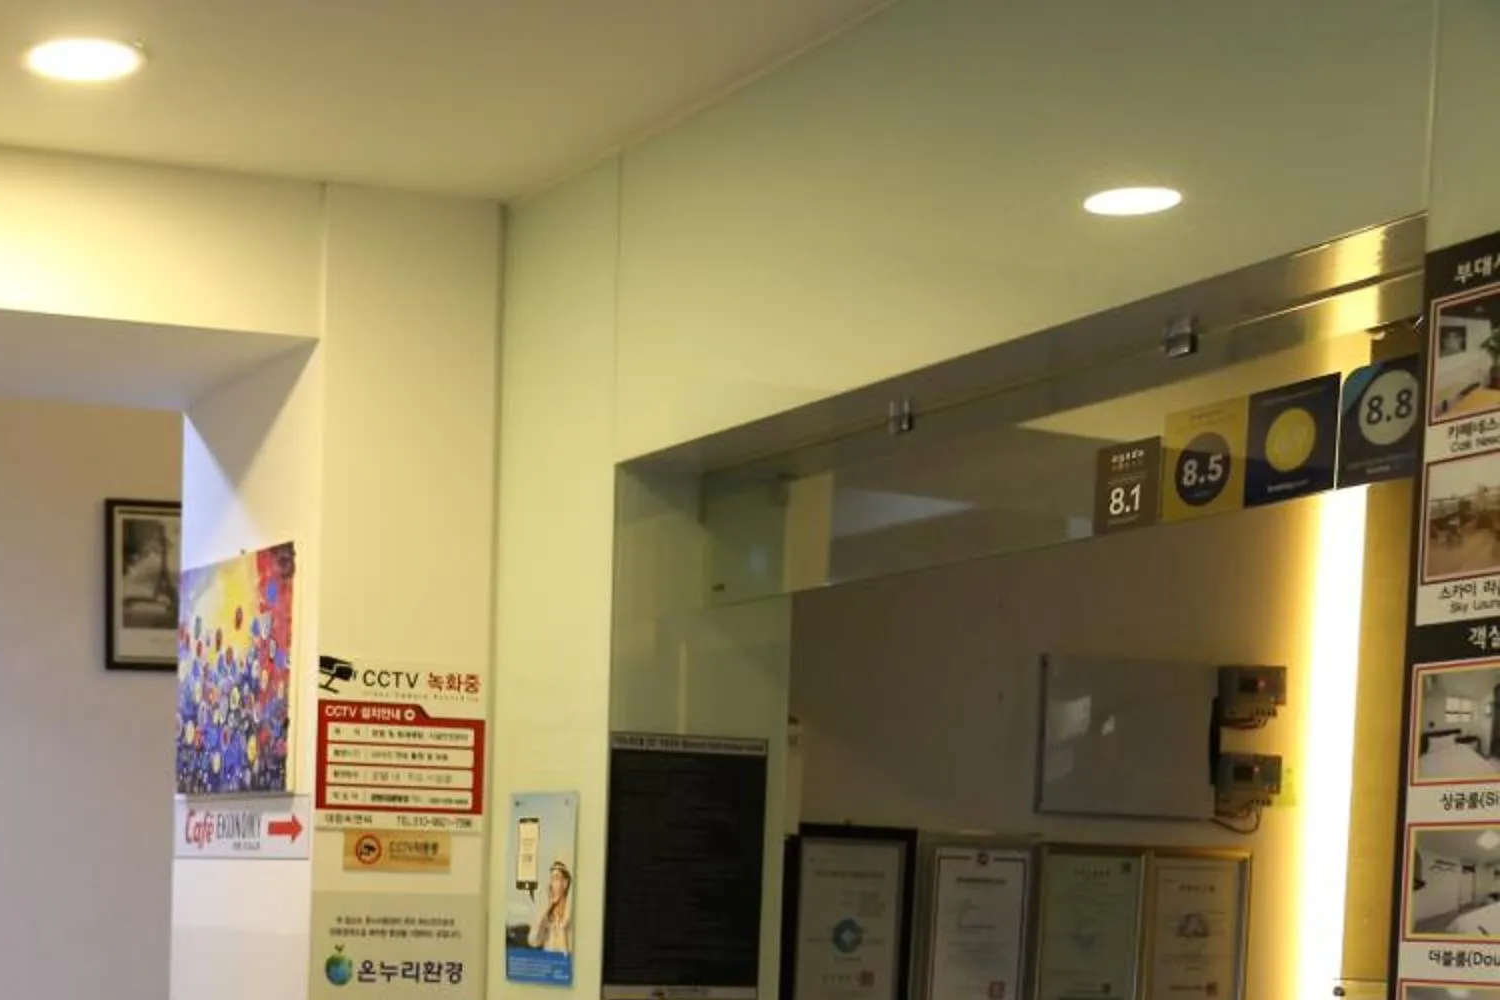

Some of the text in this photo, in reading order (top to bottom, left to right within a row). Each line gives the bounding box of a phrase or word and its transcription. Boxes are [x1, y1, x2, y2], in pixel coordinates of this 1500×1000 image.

[1366, 388, 1414, 426] 8.8
[1182, 452, 1224, 487] 8.5
[1109, 483, 1141, 515] 8.1
[363, 670, 481, 694] CCTV 녹화중
[324, 704, 357, 718] CCTV
[357, 959, 464, 985] 온누리환경
